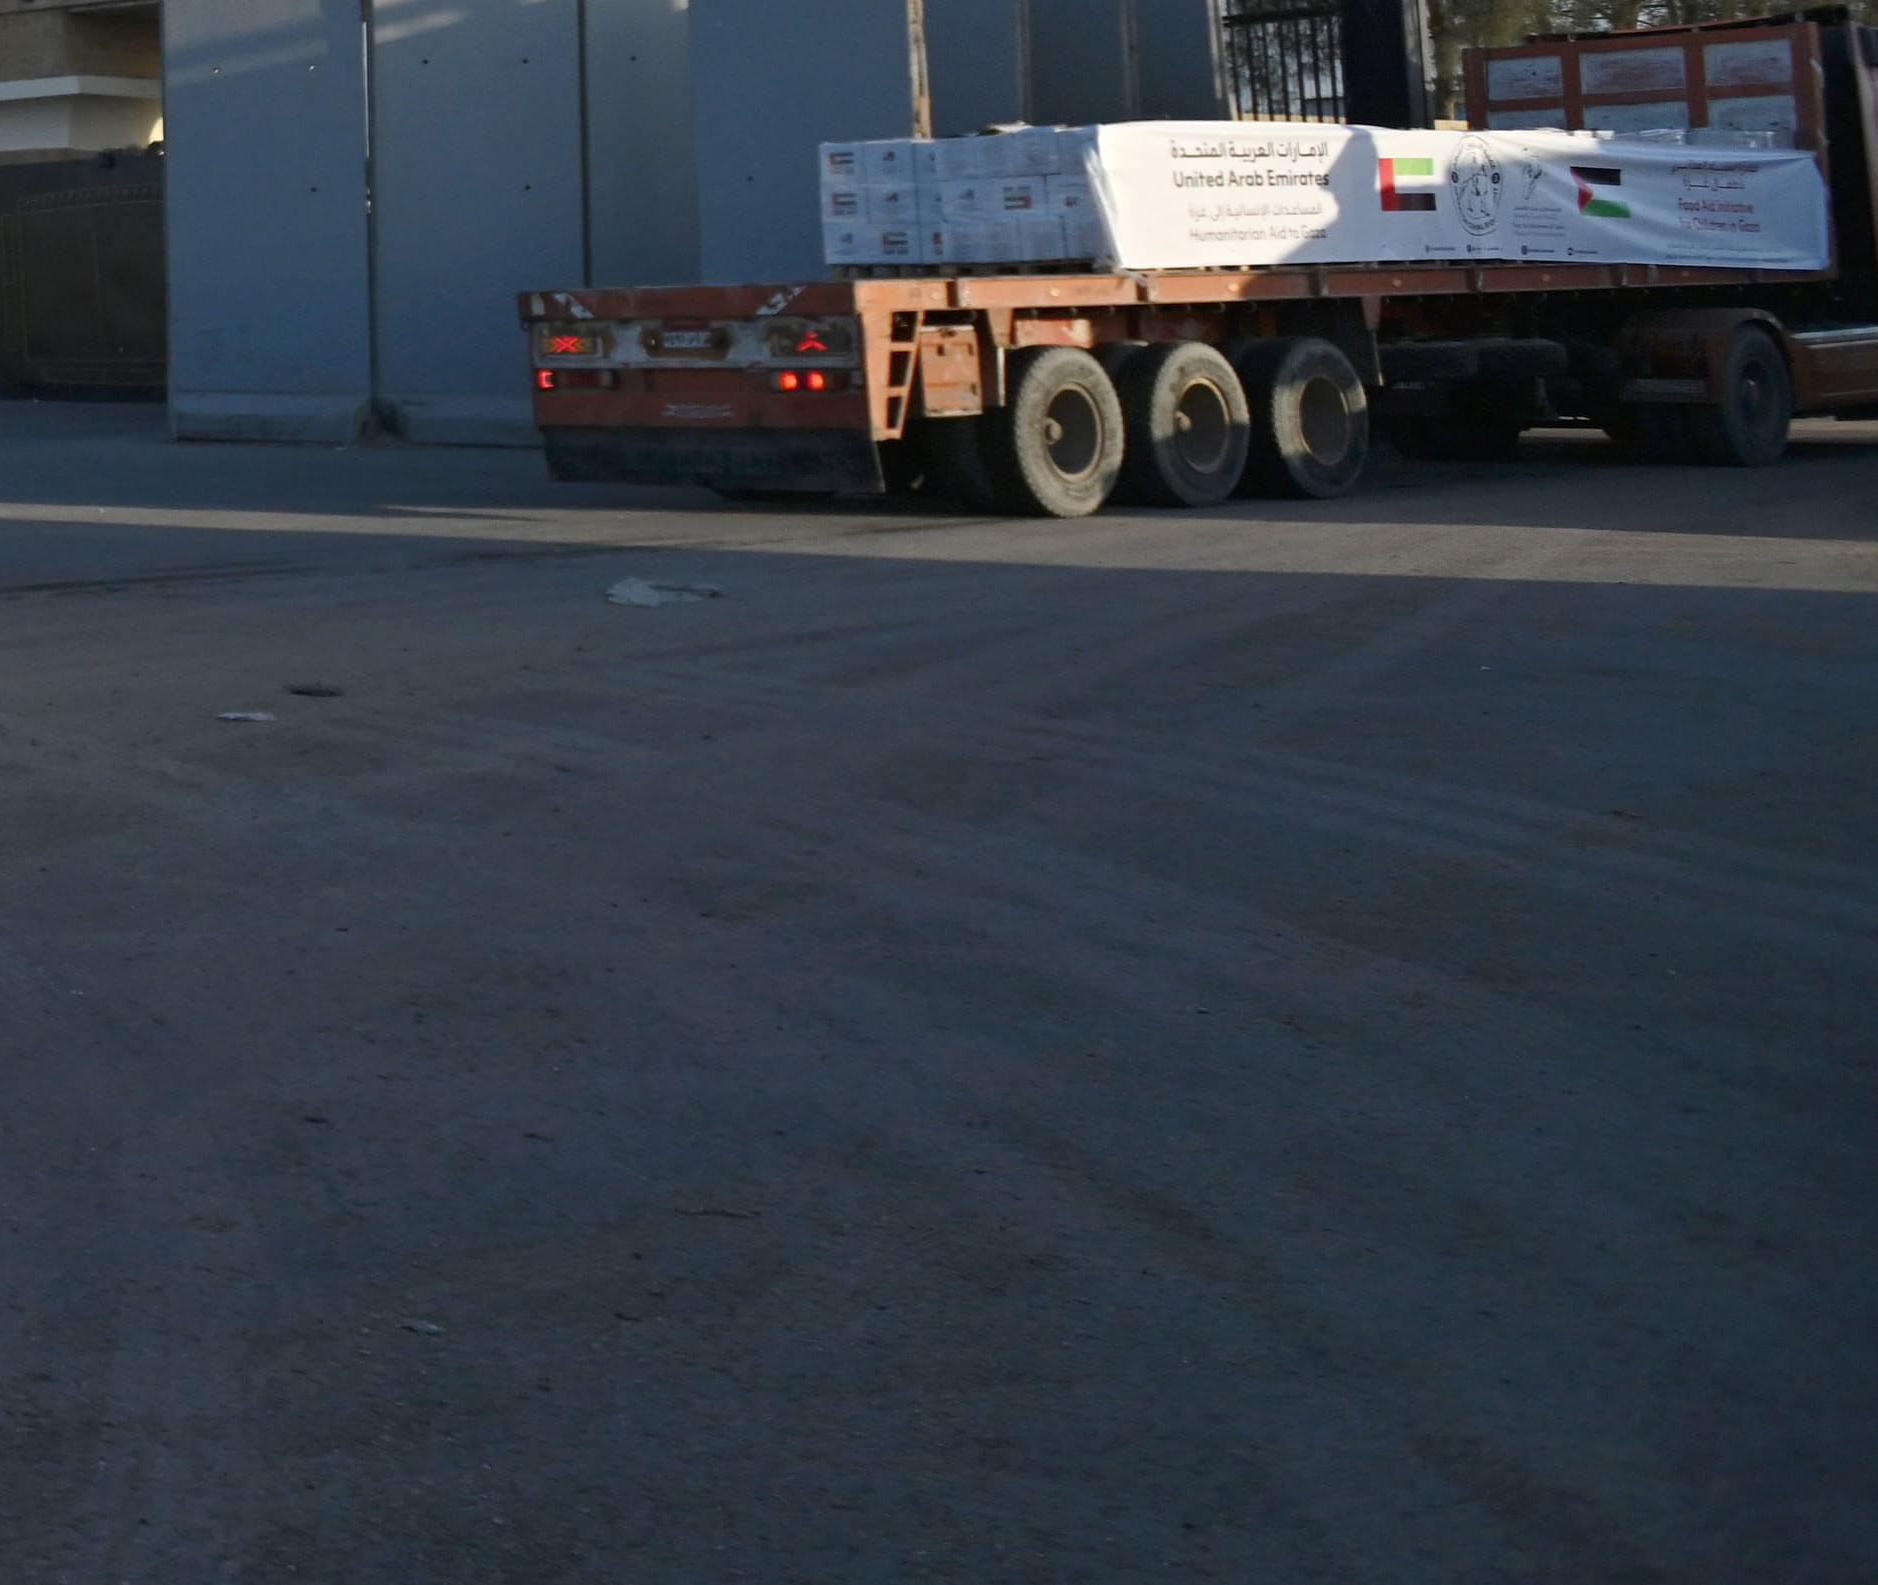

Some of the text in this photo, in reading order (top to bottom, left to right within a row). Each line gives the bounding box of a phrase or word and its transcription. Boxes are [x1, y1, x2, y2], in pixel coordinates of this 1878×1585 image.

[1173, 170, 1330, 187] United Arab Emirates
[1301, 225, 1327, 239] Gaza
